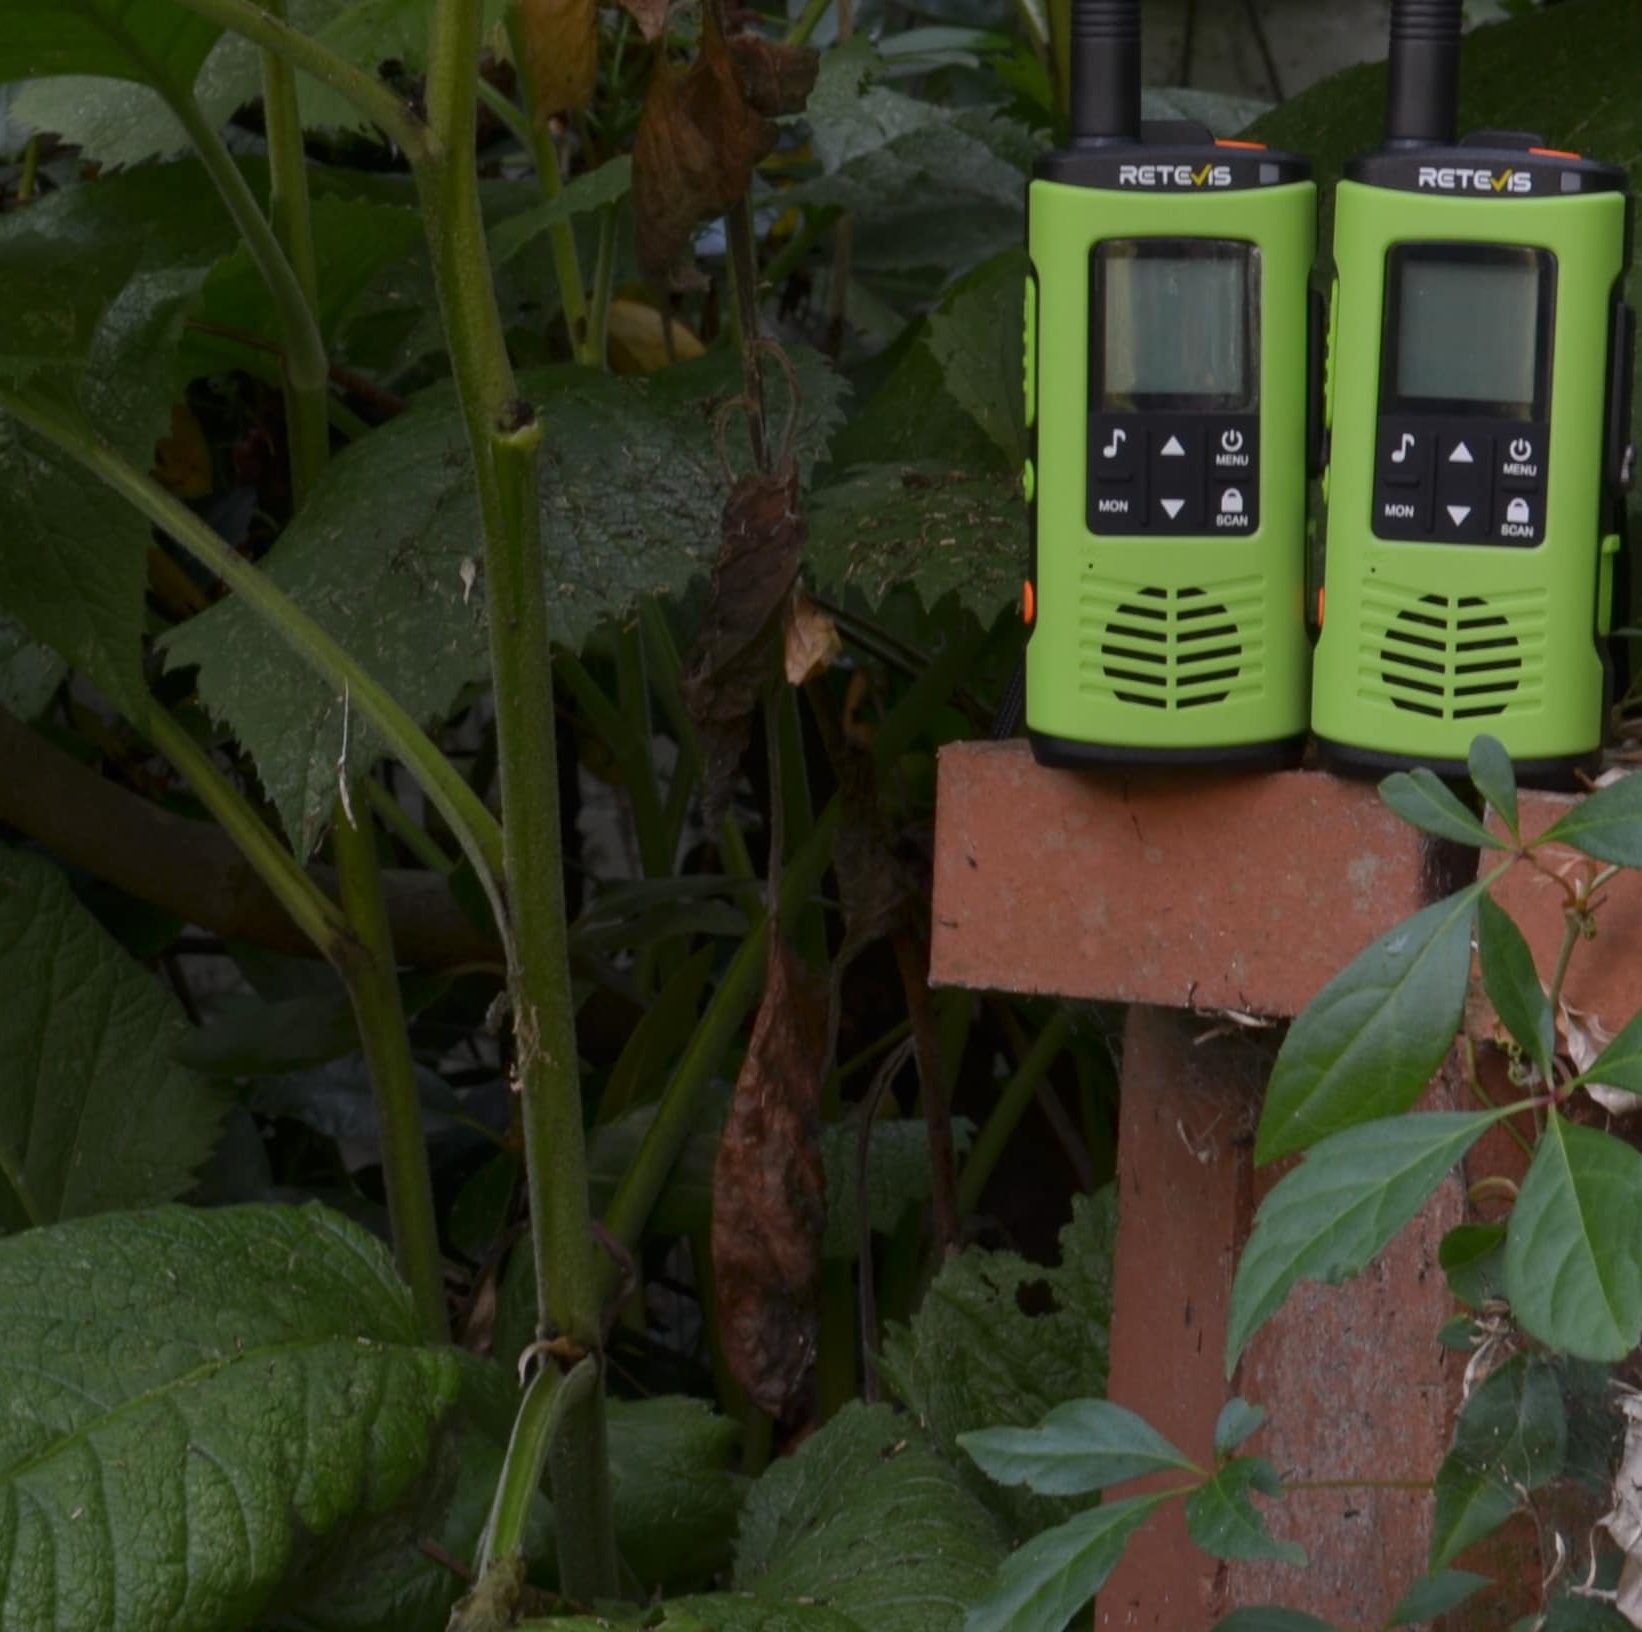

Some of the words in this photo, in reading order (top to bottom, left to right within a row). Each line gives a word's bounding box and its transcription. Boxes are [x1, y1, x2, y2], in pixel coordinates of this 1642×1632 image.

[1119, 164, 1232, 187] RETEVIS
[1418, 167, 1532, 193] RETEVIS
[1215, 453, 1249, 466] MENU
[1503, 463, 1537, 477] MENU
[1098, 499, 1129, 513] MON
[1384, 503, 1415, 518] MON
[1215, 514, 1249, 527] SCAN
[1500, 523, 1534, 538] SCAN
